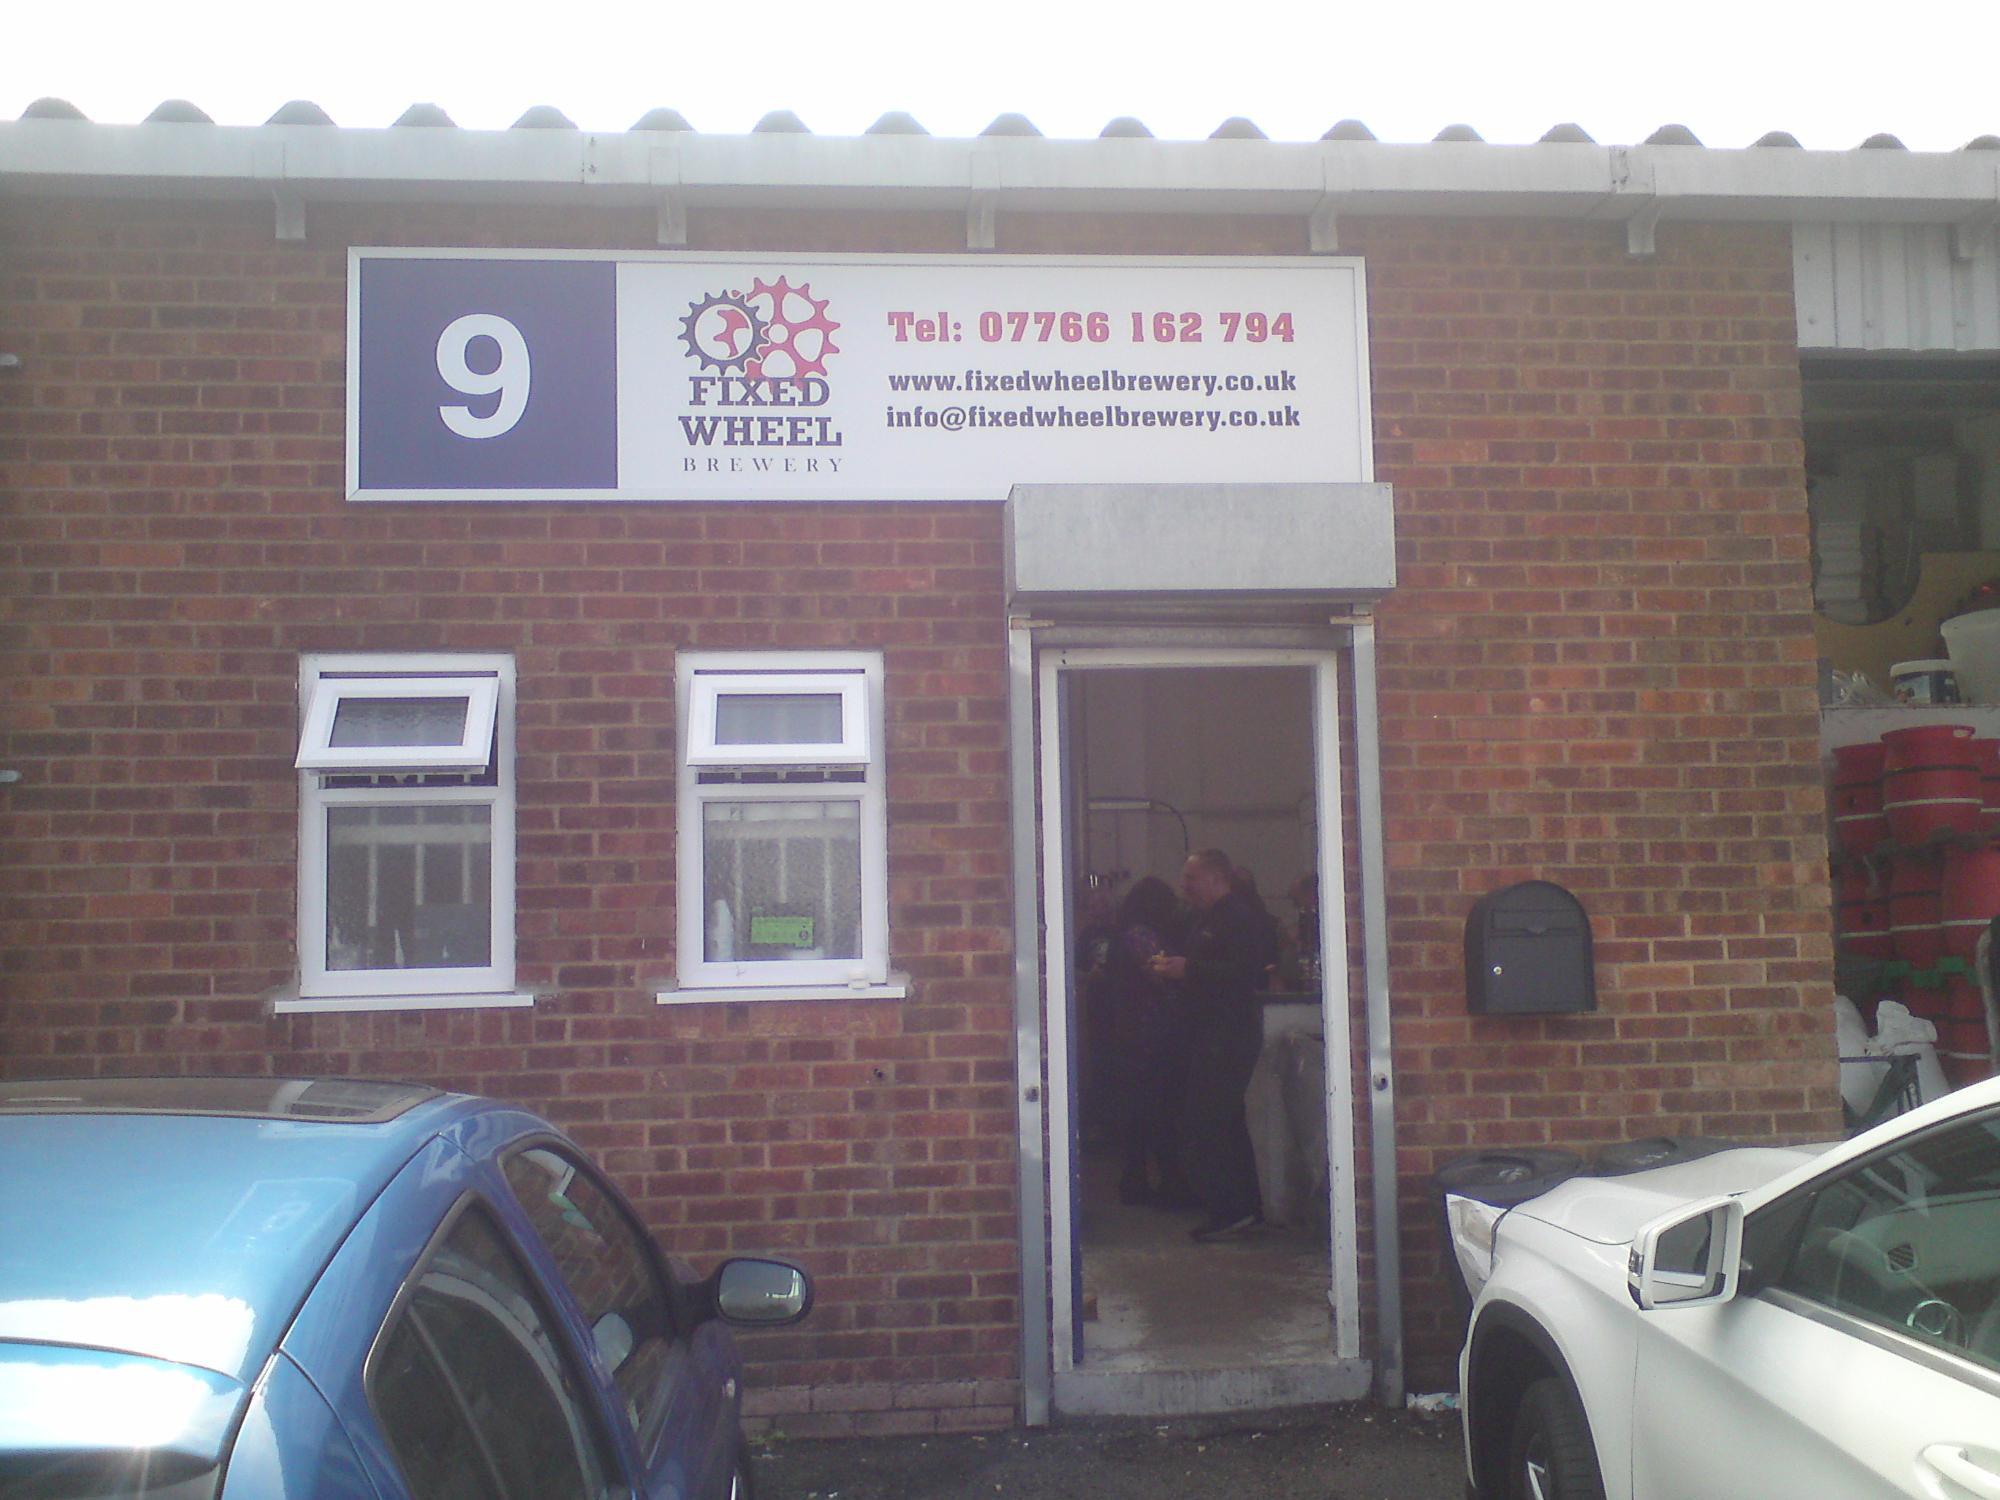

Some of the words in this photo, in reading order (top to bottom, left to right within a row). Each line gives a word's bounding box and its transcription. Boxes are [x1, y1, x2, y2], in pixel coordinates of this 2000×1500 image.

[886, 311, 963, 343] Tel:
[978, 311, 1111, 343] 07766
[1130, 311, 1204, 343] 162
[1218, 311, 1296, 343] 794
[435, 312, 532, 440] 9
[687, 375, 831, 407] FIXED
[888, 369, 1297, 397] www.fixedwheelbrewery.co.uk
[677, 415, 843, 447] WHEEL
[886, 405, 1301, 433] info@fixedwheelbrewery.co.uk
[682, 456, 844, 473] BREWERY
